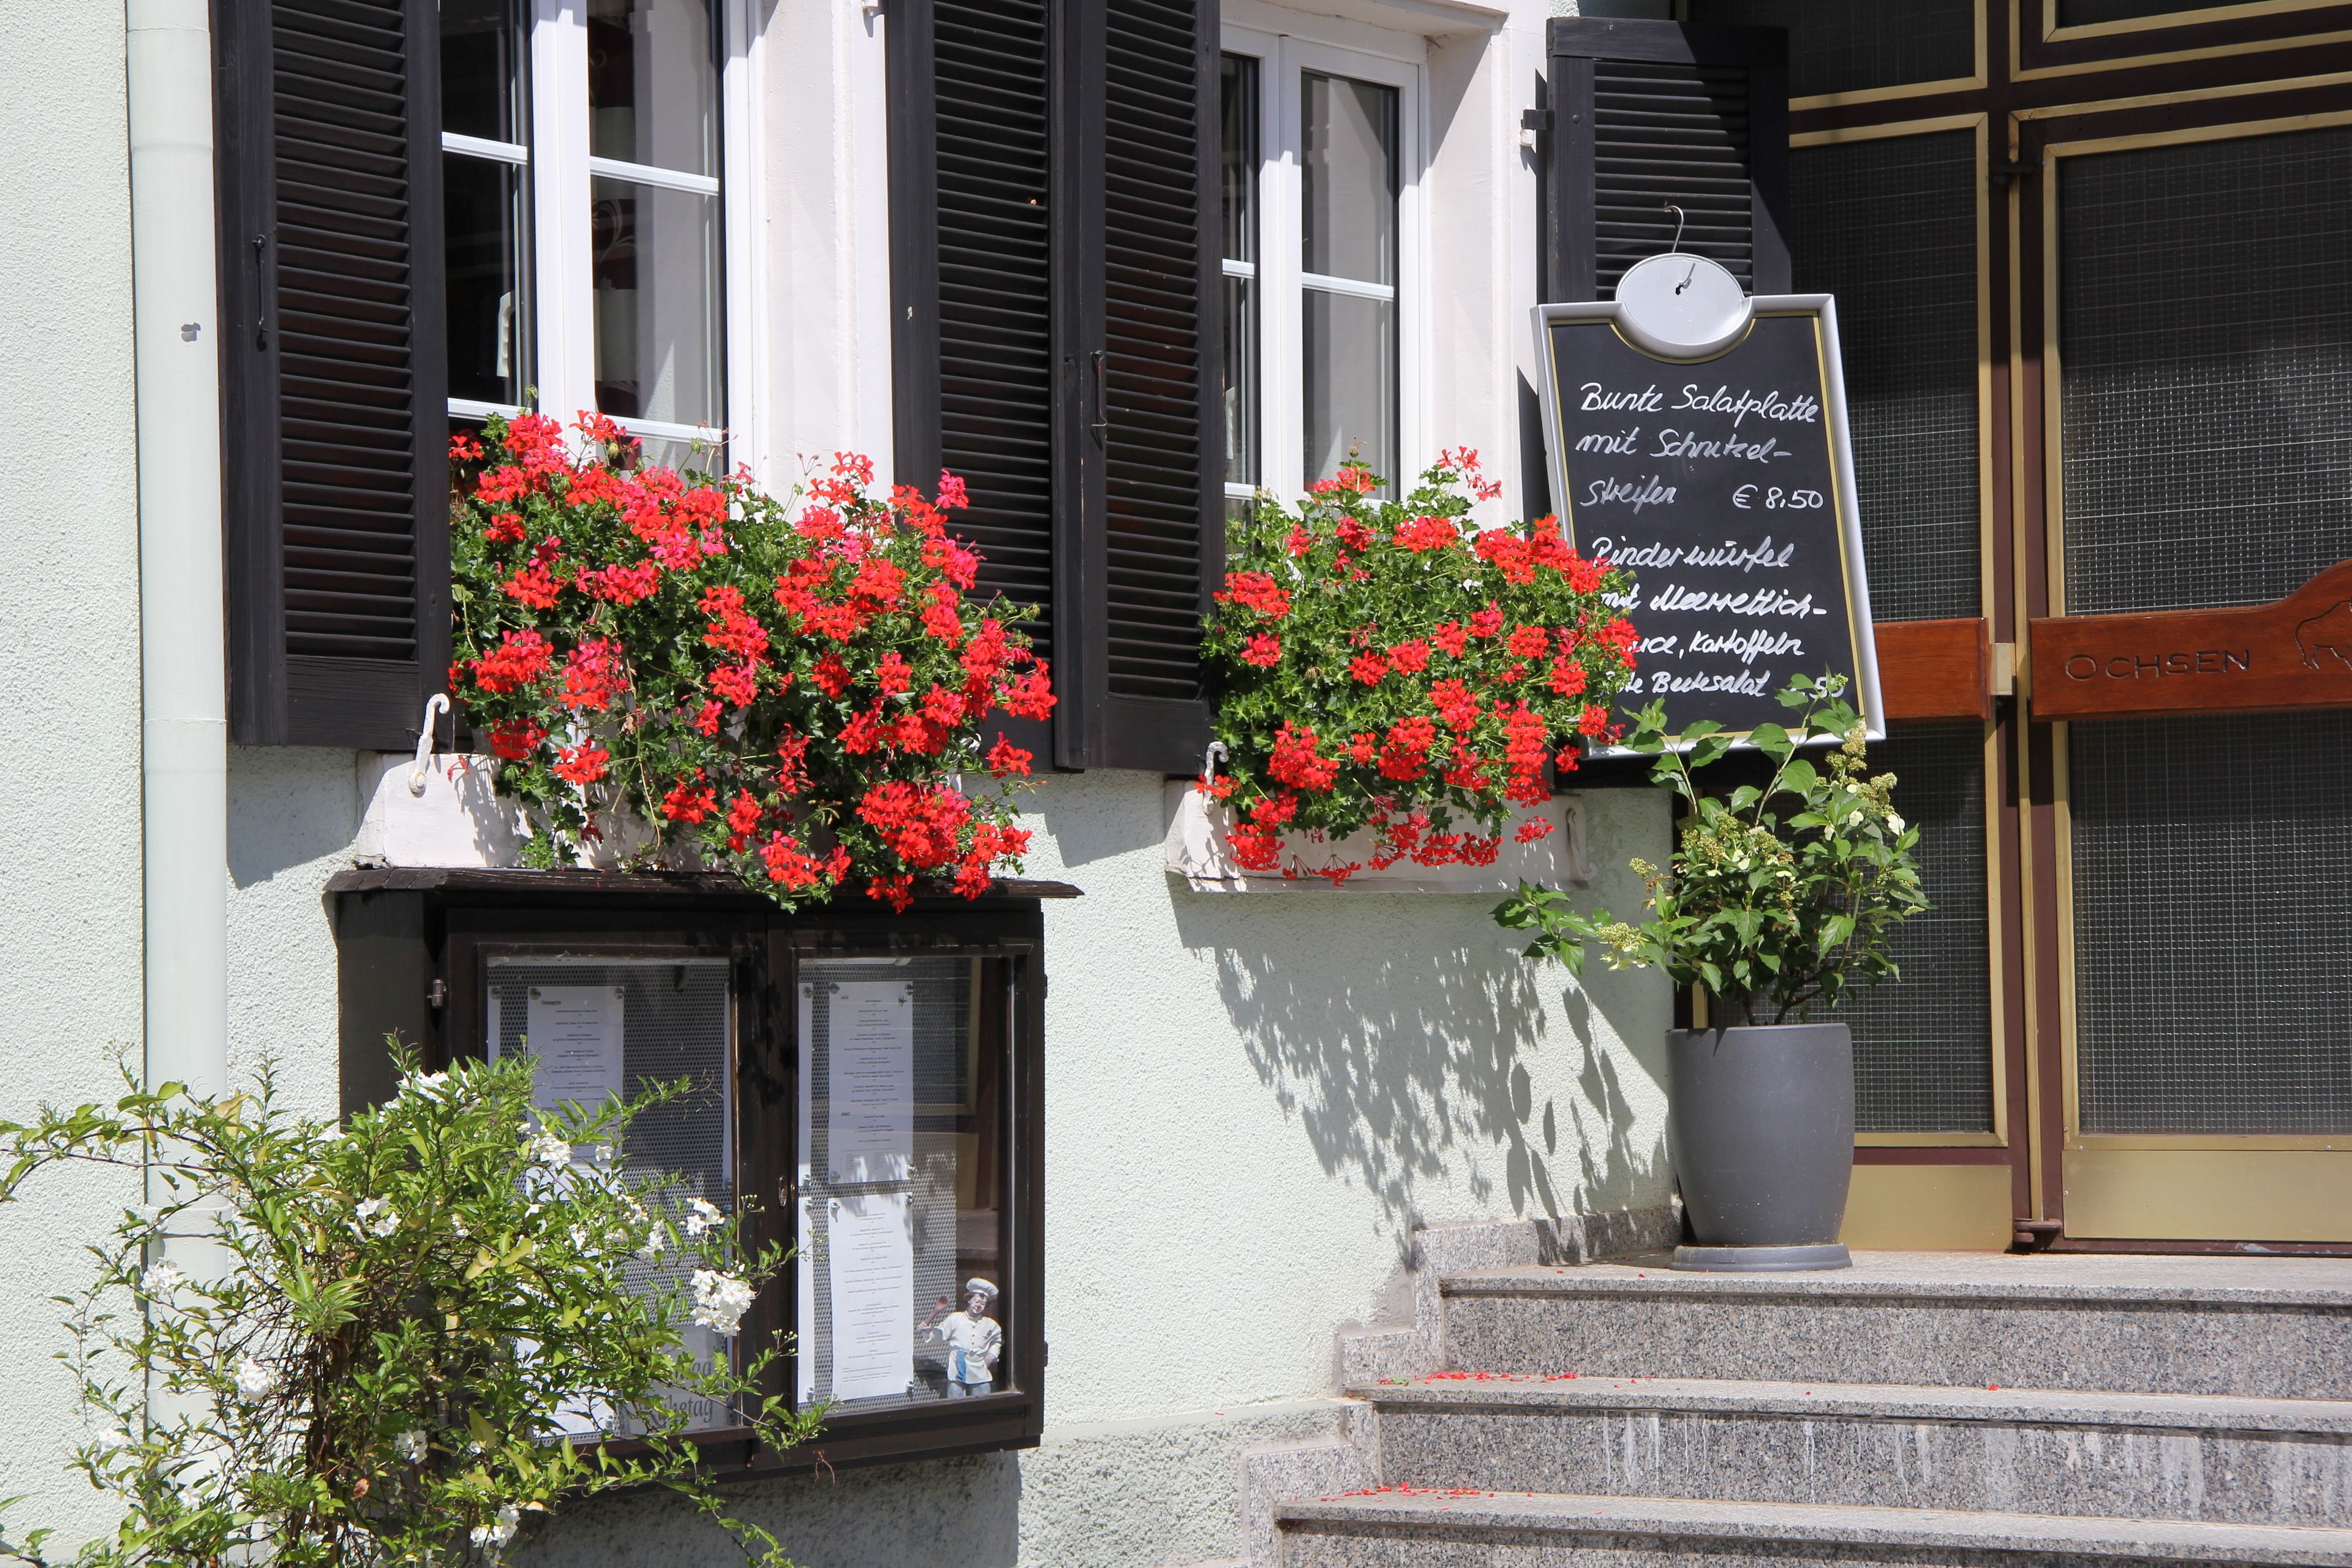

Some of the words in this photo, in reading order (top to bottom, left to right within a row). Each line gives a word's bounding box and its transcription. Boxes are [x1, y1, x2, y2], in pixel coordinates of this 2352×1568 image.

[1580, 382, 1663, 413] Bunte
[1671, 383, 1819, 428] Salatplatte
[1575, 426, 1640, 455] mit
[1579, 474, 1677, 515] Streifen
[1732, 484, 1758, 510] €
[1765, 486, 1824, 510] 8,50
[1600, 582, 1642, 610] mit
[1649, 583, 1828, 619] Meerrettich-
[1687, 628, 1805, 666] Kartoffeln
[2065, 649, 2250, 681] OCHSEN
[1651, 669, 1771, 697] Beetesalat
